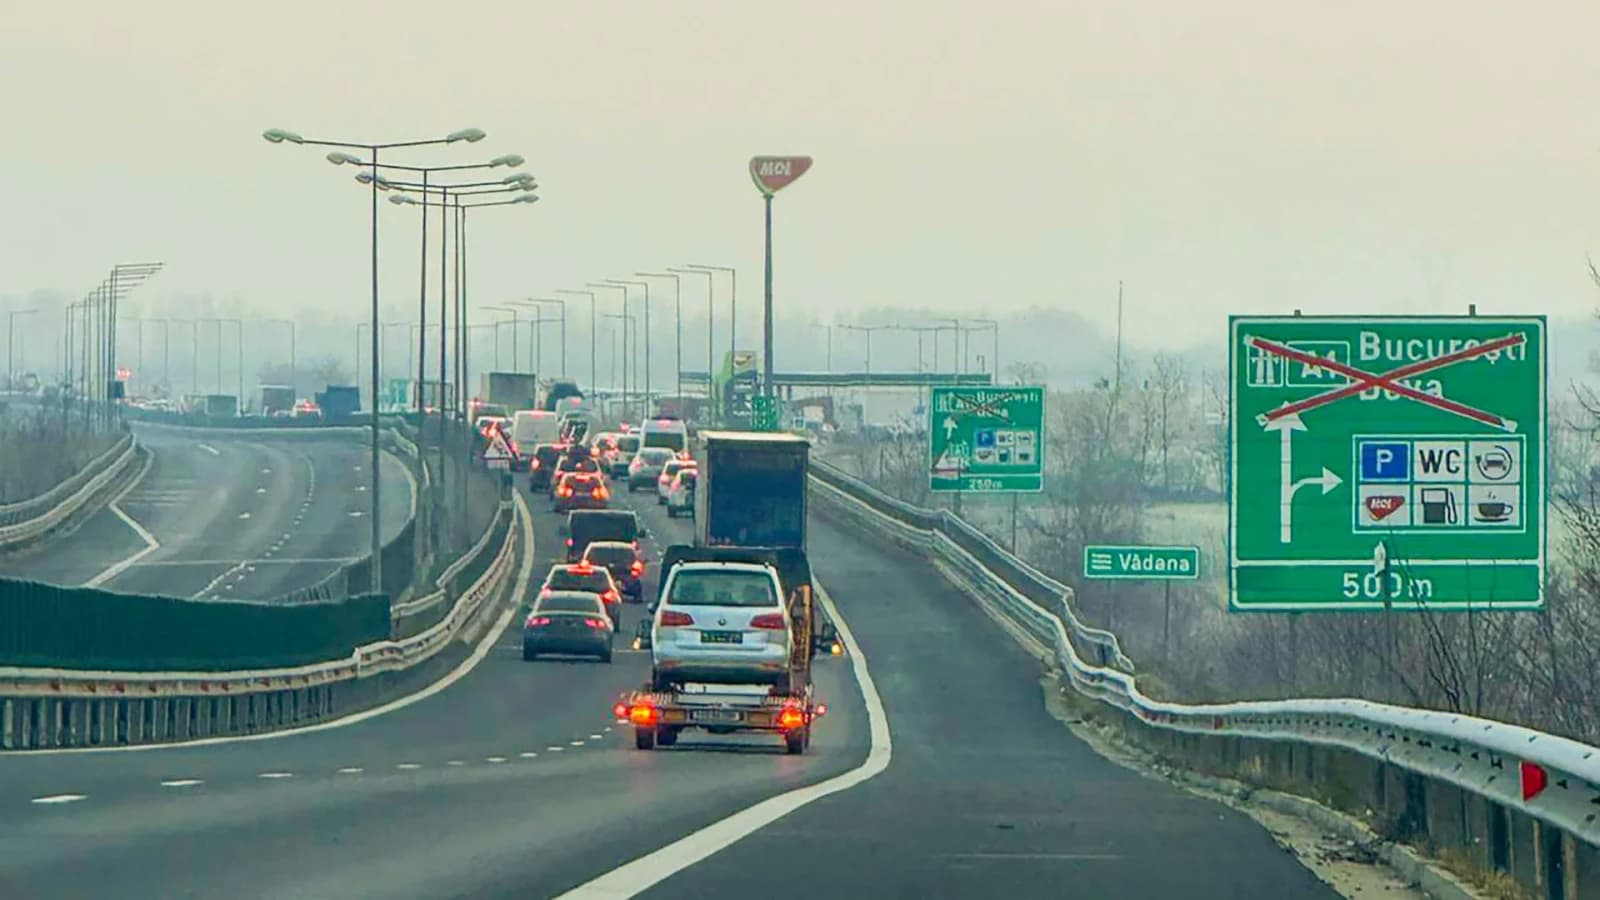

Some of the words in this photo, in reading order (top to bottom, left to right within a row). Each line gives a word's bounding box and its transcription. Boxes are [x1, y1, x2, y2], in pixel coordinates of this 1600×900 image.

[760, 161, 791, 176] MOL
[1376, 448, 1393, 474] P
[1419, 449, 1460, 474] WC
